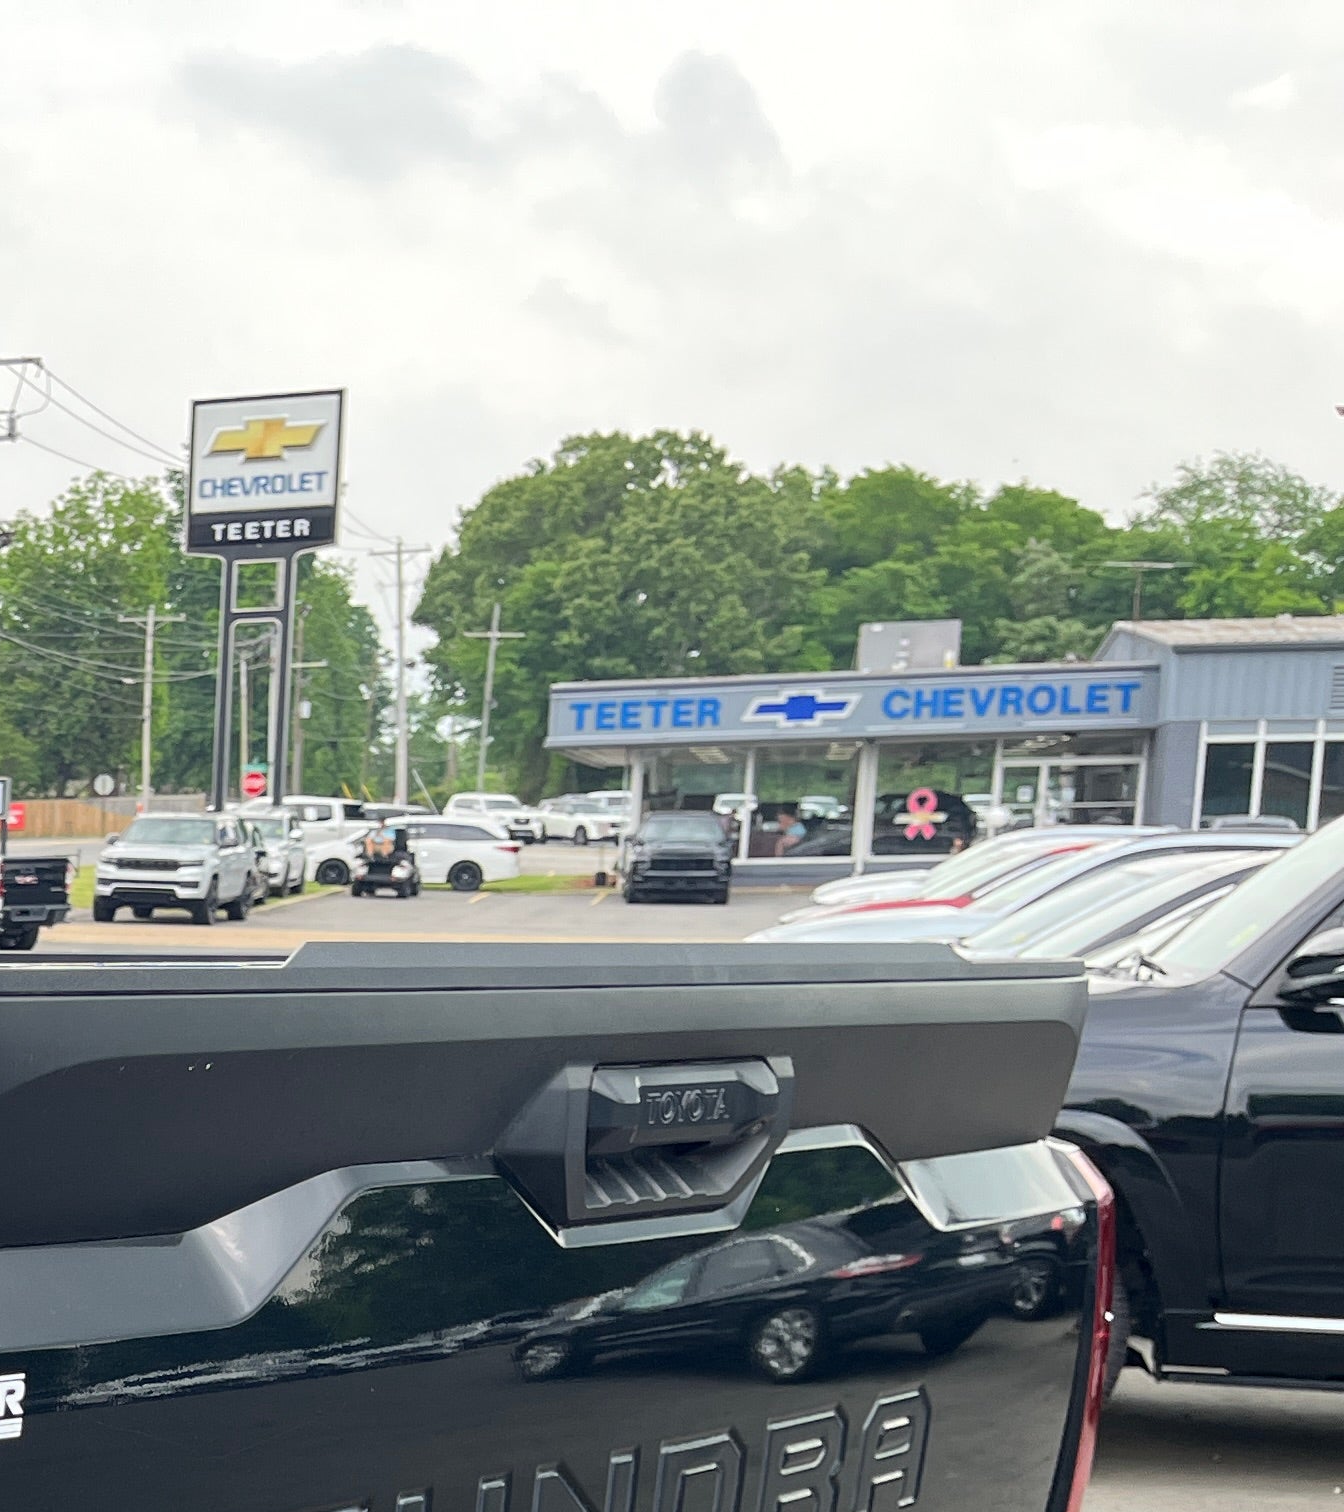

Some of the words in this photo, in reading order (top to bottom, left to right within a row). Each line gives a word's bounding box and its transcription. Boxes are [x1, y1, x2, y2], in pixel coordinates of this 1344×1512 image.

[198, 471, 328, 499] CHEVROLET
[211, 519, 311, 542] TEETER
[570, 697, 722, 731] TEETER
[882, 682, 1140, 719] CHEVROLET
[646, 1088, 730, 1125] TOYOTA
